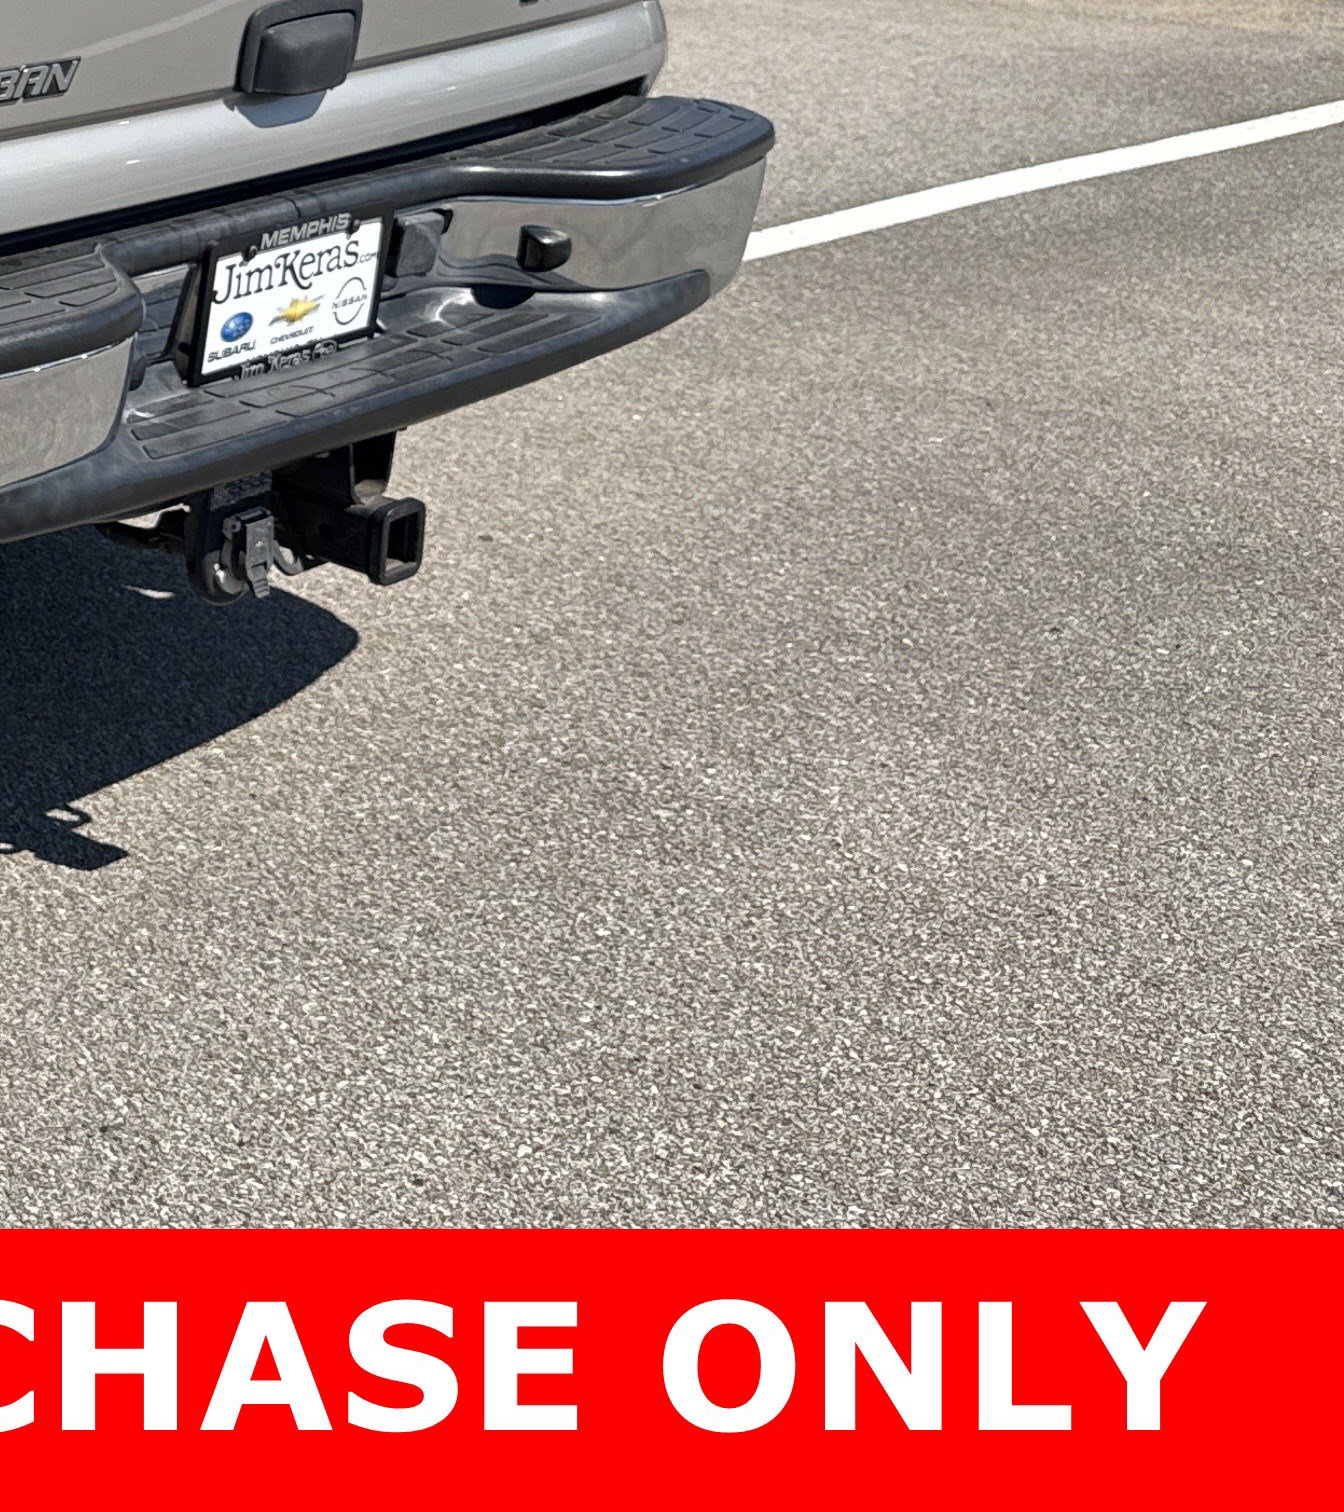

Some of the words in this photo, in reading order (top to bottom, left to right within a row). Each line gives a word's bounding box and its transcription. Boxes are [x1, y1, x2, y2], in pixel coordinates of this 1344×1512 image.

[261, 213, 352, 249] MEMPHIS
[331, 293, 368, 309] NISSAN
[207, 339, 256, 362] SUBARU
